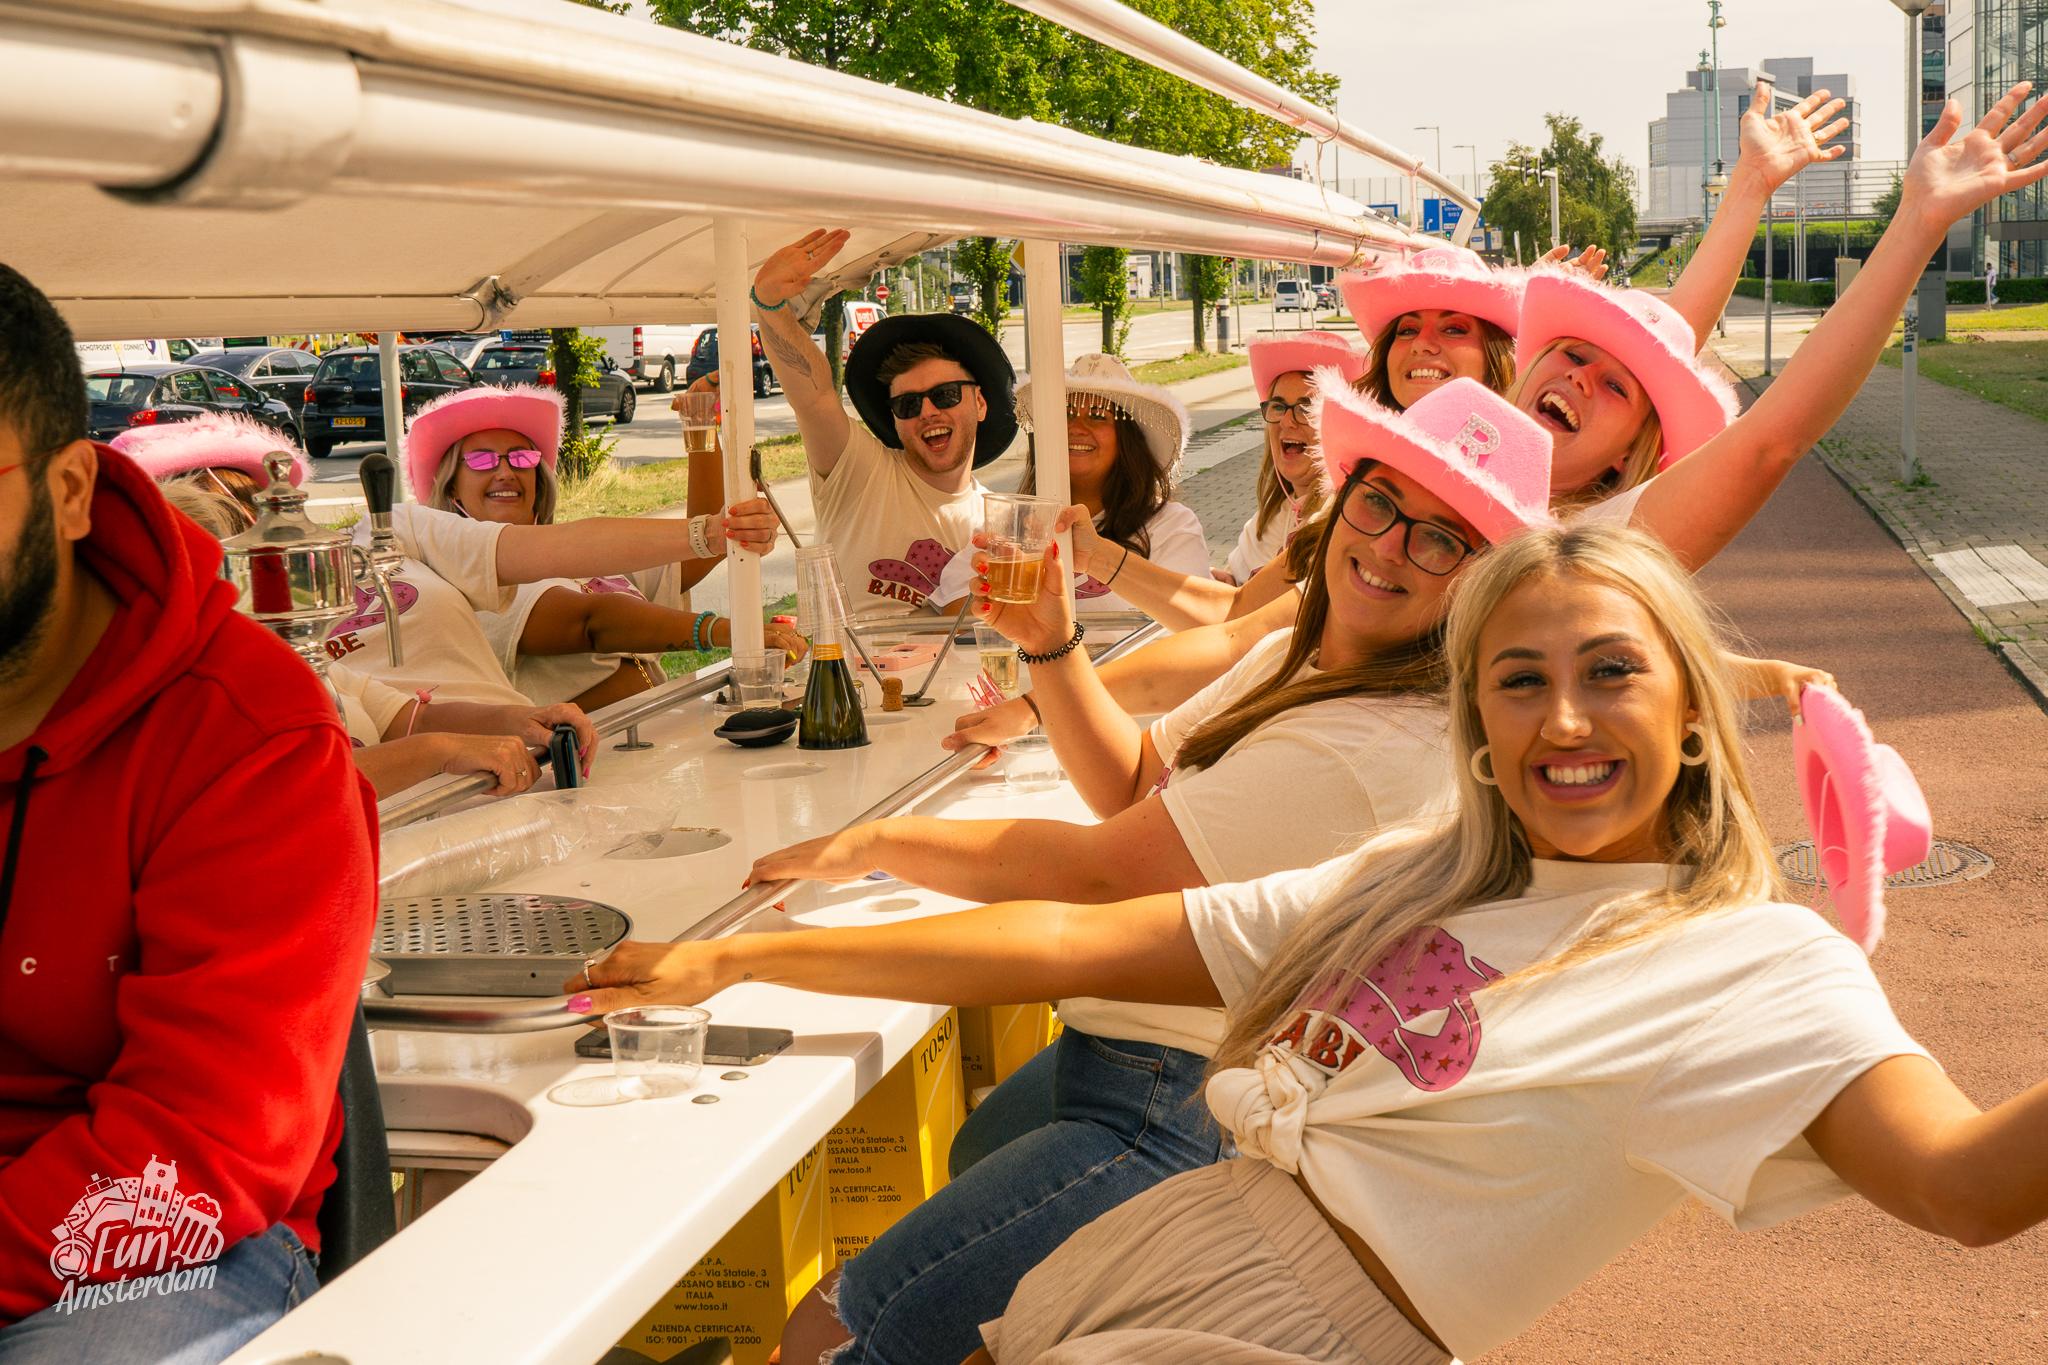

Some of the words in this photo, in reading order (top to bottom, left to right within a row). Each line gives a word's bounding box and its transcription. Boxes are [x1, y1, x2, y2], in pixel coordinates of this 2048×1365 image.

[1455, 412, 1501, 470] R
[867, 579, 926, 608] BABE
[325, 632, 366, 661] BE
[920, 1016, 952, 1075] TOSO
[1266, 1012, 1366, 1072] AB
[829, 1127, 843, 1135] SO
[845, 1126, 868, 1135] S.P.A.
[851, 1136, 865, 1144] Via
[866, 1136, 897, 1144] Statale,
[899, 1135, 905, 1143] 3
[828, 1146, 859, 1154] SSANO
[861, 1145, 886, 1153] BELBO
[894, 1145, 907, 1153] CN
[835, 1156, 860, 1165] ITALIA
[842, 1185, 896, 1193] CERTIFICATA:
[847, 1195, 869, 1203] 14001
[834, 1236, 870, 1245] NTIENE
[837, 1247, 851, 1256] da
[705, 1269, 721, 1277] Via
[723, 1268, 759, 1278] Statale,
[761, 1269, 767, 1277] 3
[675, 1280, 714, 1288] OSSANO
[717, 1280, 746, 1288] BELBO
[755, 1280, 770, 1289] CN
[686, 1291, 714, 1299] ITALIA
[674, 1302, 728, 1311] www.toso.it
[651, 1325, 692, 1333] AZIENDA
[694, 1324, 755, 1333] CERTIFICATA:
[645, 1336, 665, 1345] ISO:
[667, 1335, 688, 1345] 9001
[733, 1335, 762, 1345] 22000
